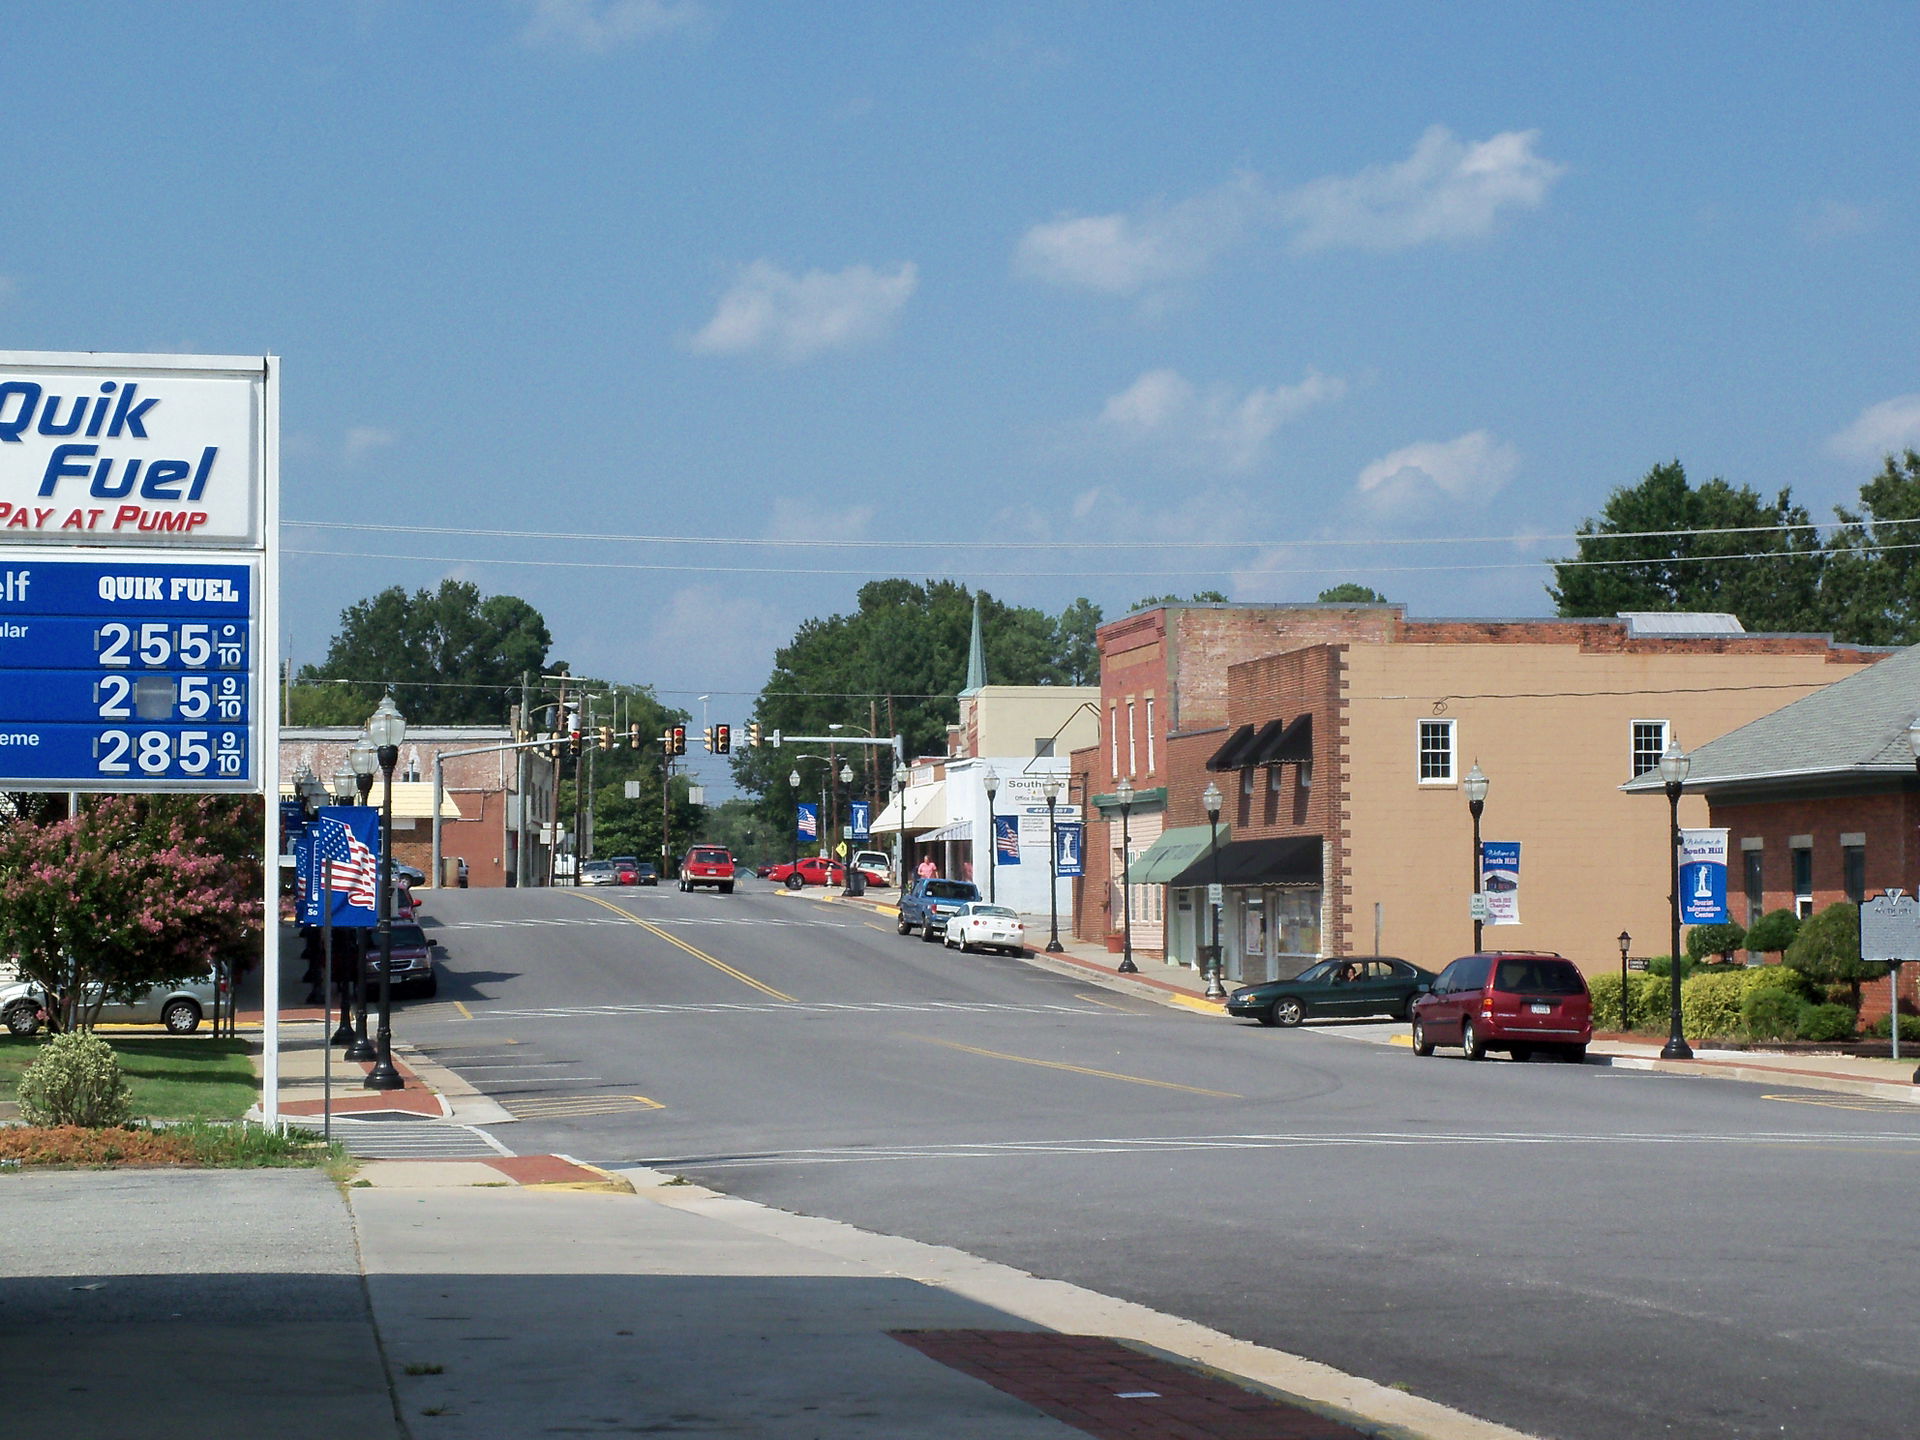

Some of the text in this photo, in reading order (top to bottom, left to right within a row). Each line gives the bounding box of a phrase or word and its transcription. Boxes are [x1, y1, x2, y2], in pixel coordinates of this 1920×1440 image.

[0, 381, 160, 442] Quik
[38, 444, 219, 501] Fuel
[62, 508, 104, 529] AT
[113, 505, 208, 532] PUMP
[0, 570, 30, 601] lf
[99, 576, 239, 602] QUIK FUEL
[0, 622, 29, 638] lar
[99, 622, 211, 666] 255
[99, 730, 210, 773] 285
[1683, 847, 1706, 855] South
